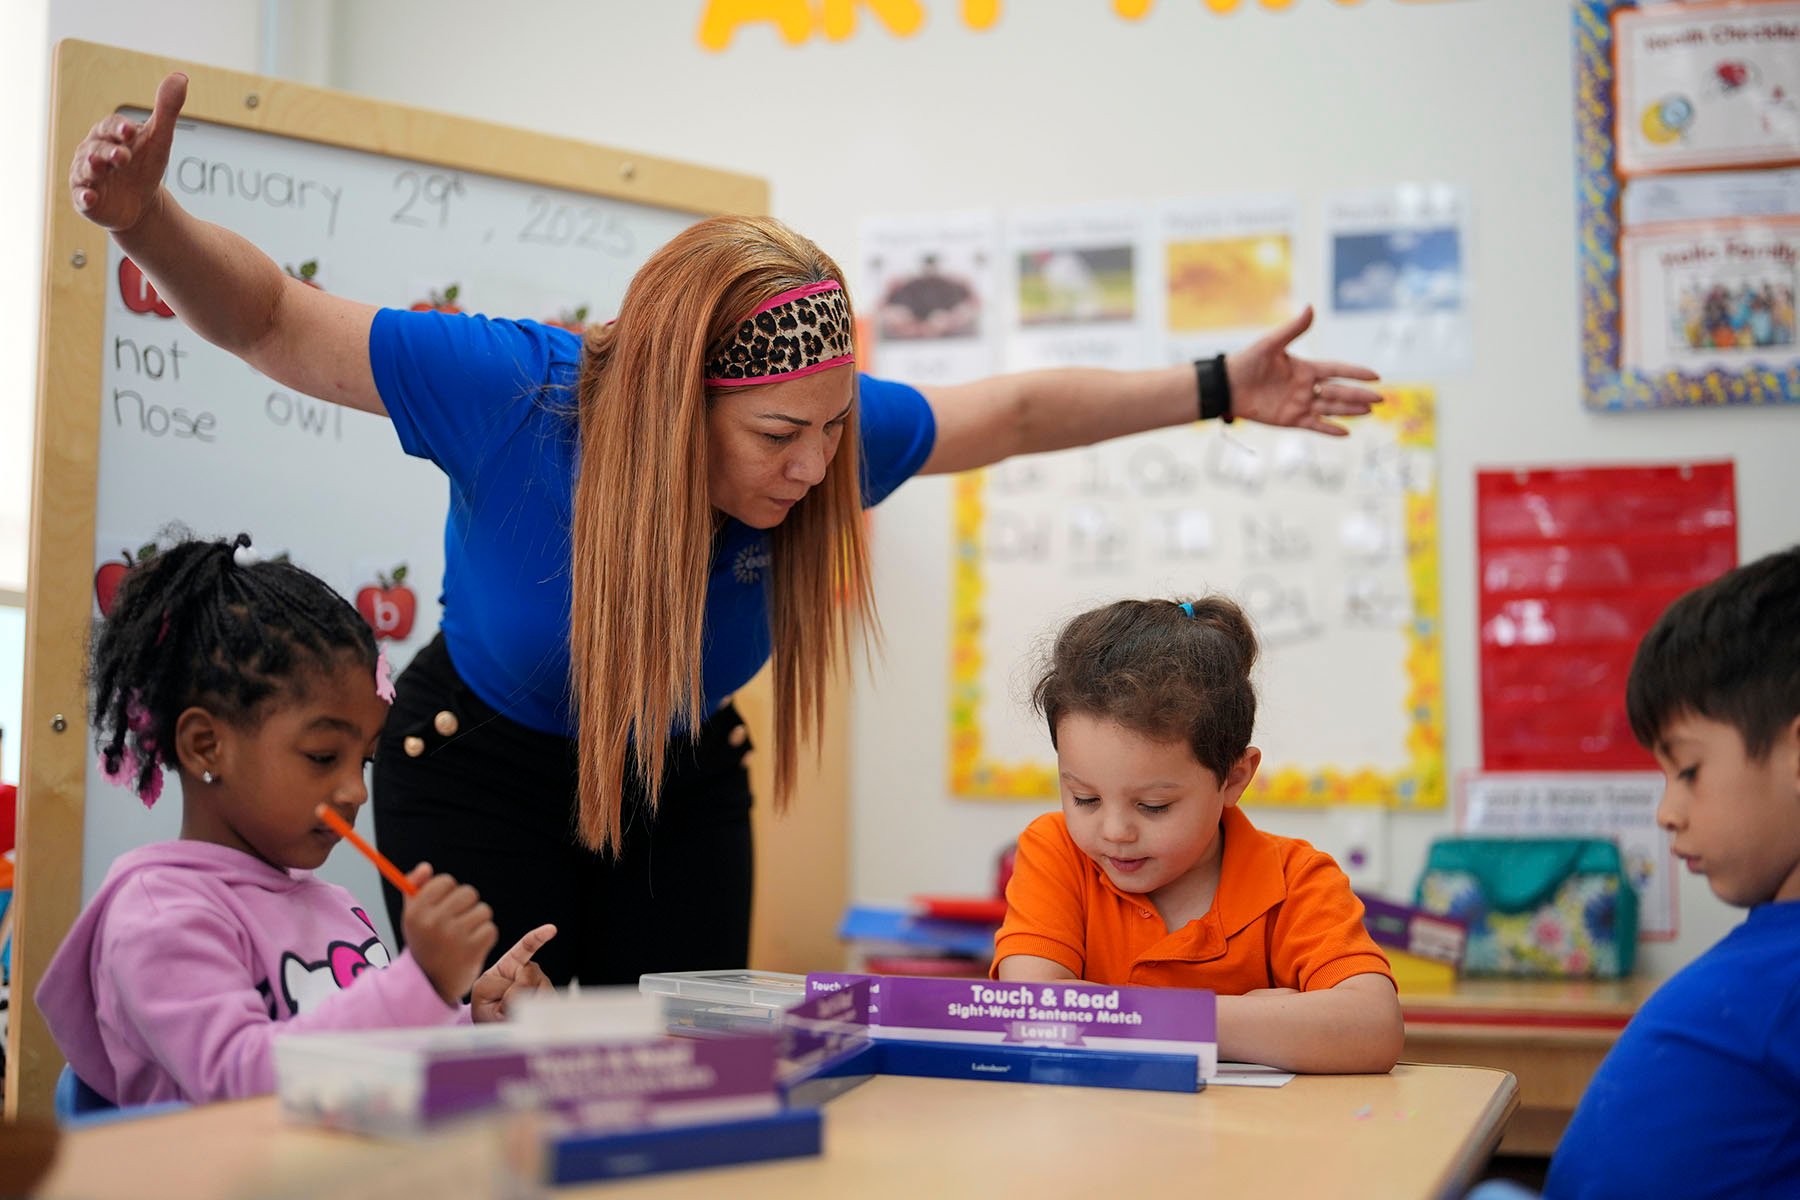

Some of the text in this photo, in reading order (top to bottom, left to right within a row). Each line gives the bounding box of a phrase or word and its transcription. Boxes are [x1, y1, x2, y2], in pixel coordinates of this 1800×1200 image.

[165, 156, 343, 237] anuary
[517, 193, 638, 258] 2025
[116, 335, 186, 380] not
[114, 388, 344, 443] nose owl
[373, 592, 400, 632] b
[811, 981, 841, 992] Touch
[971, 984, 1120, 1010] Touch & Read
[948, 1003, 1142, 1025] Sight-Word Sentence Match
[1020, 1025, 1057, 1039] Level
